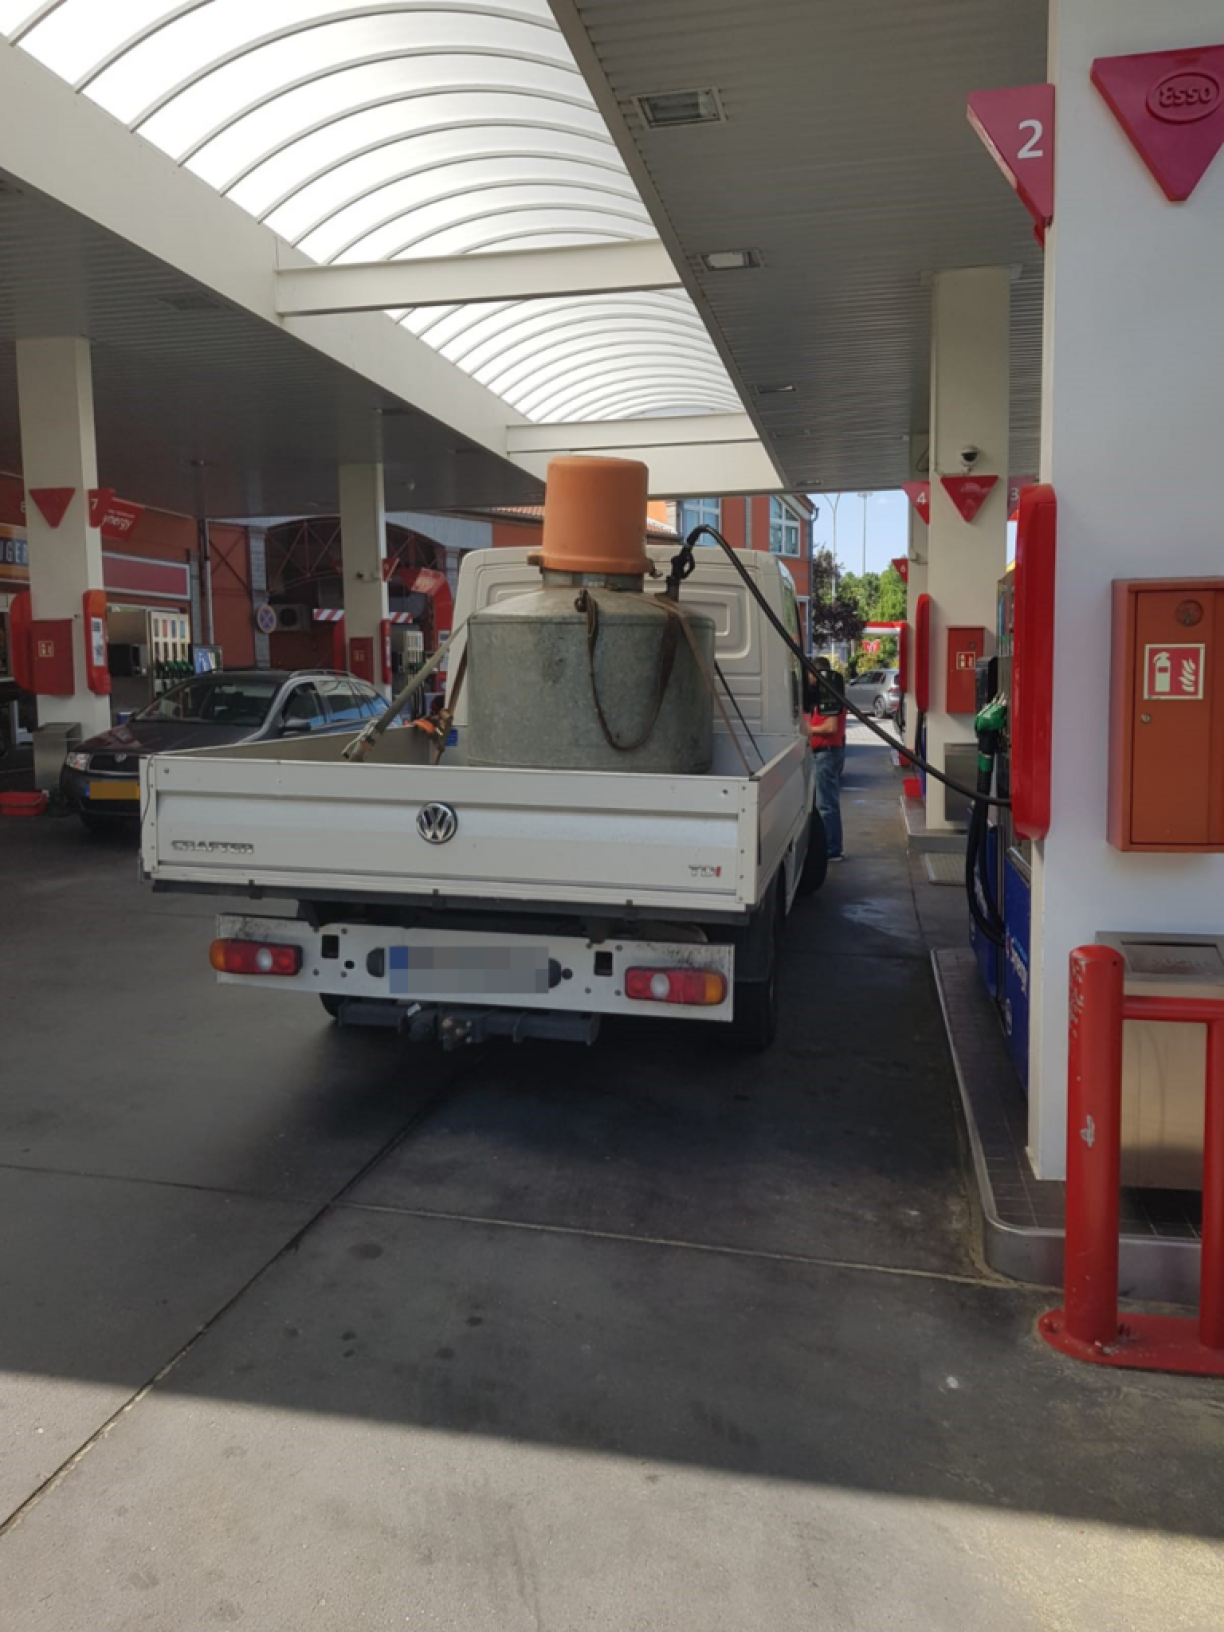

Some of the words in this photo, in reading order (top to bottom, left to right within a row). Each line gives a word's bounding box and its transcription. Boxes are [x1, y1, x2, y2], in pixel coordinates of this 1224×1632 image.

[1017, 119, 1043, 159] 2
[917, 492, 927, 505] 4
[1010, 488, 1019, 501] 3
[101, 514, 133, 531] ynergy
[688, 865, 722, 878] TDI
